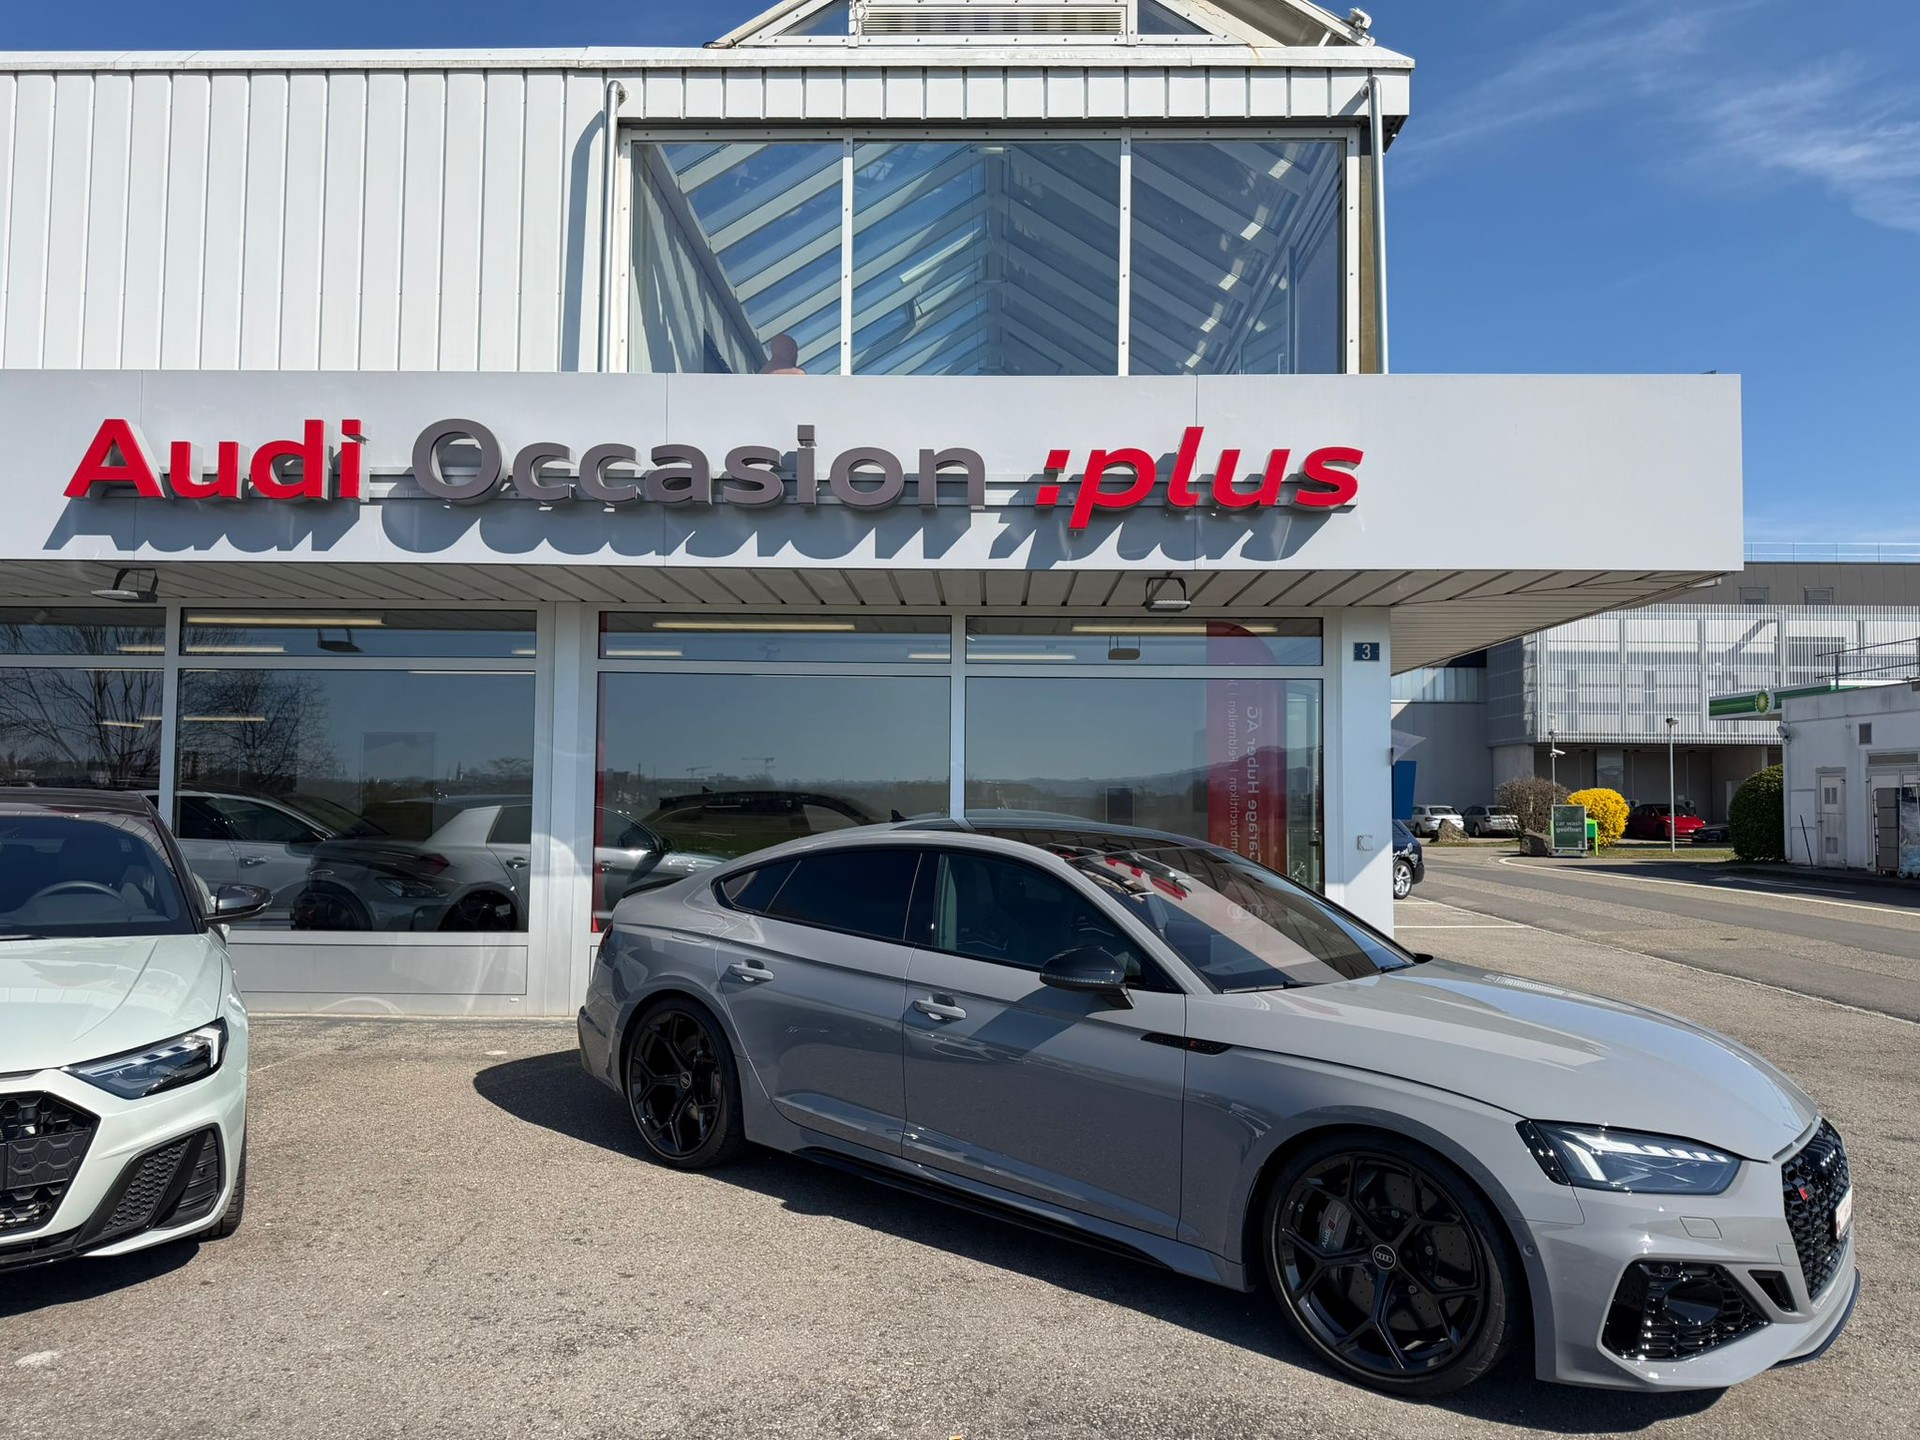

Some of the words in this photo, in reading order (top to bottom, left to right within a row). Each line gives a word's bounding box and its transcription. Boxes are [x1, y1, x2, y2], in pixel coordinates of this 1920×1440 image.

[63, 418, 361, 499] Audi
[411, 418, 986, 507] Occasion
[1362, 643, 1371, 660] 3
